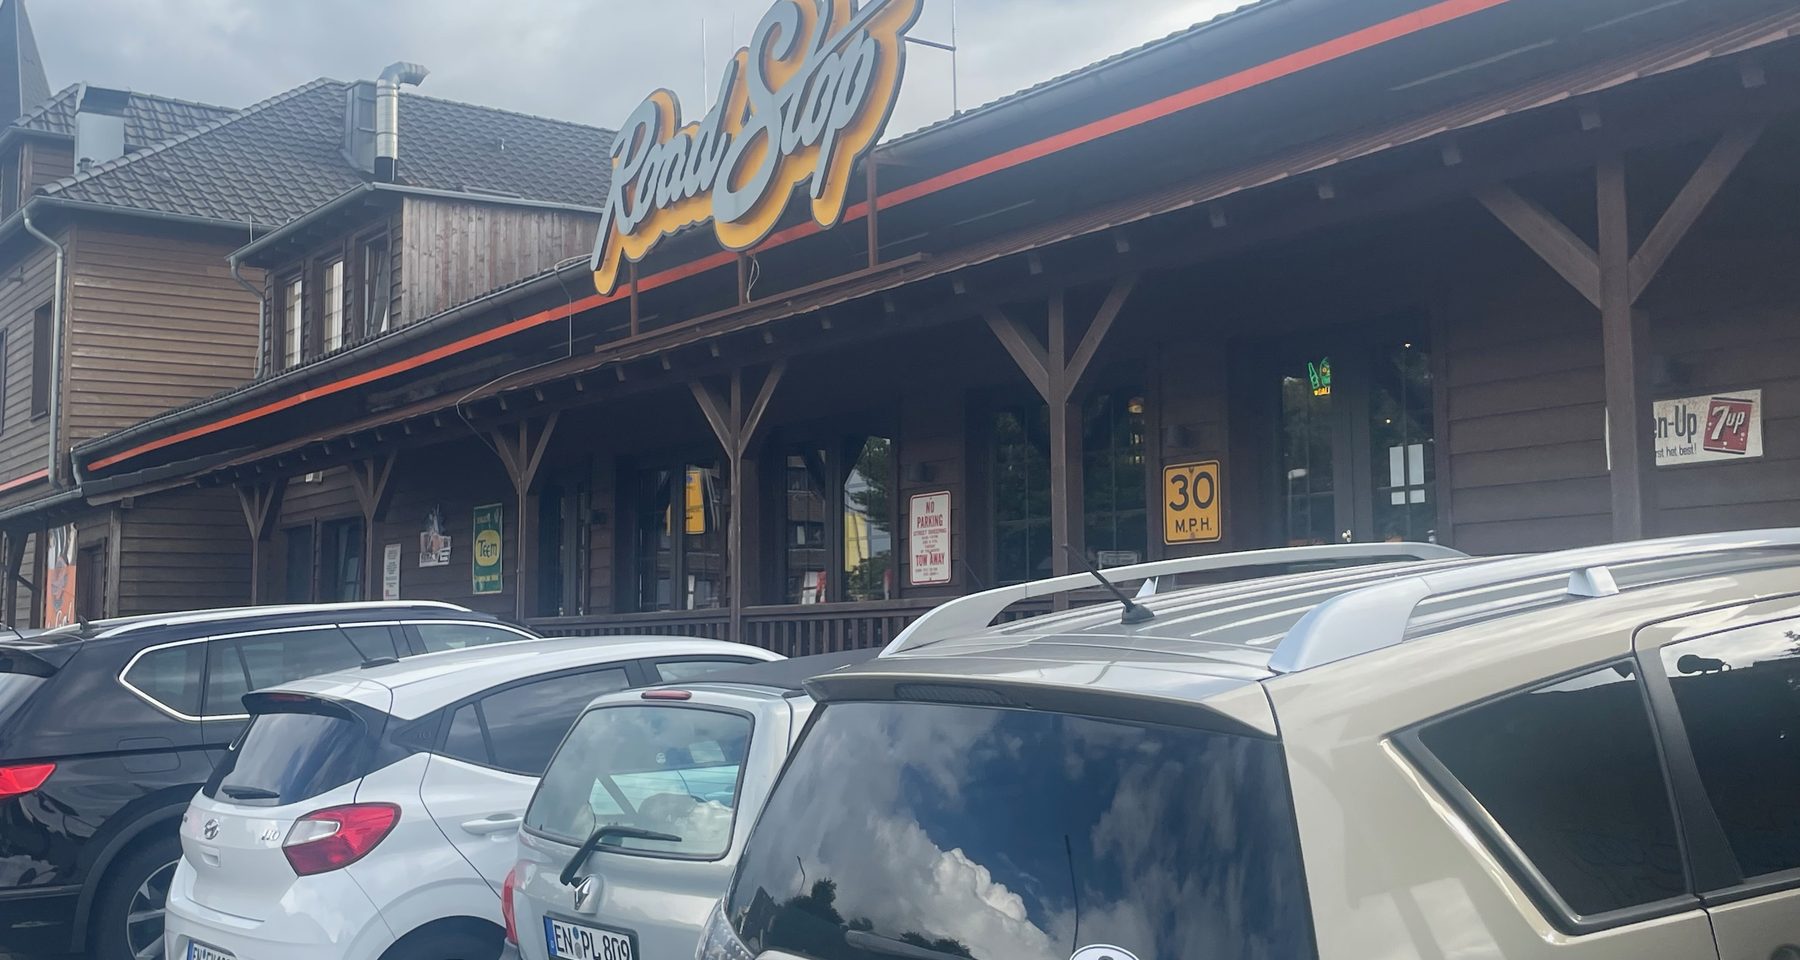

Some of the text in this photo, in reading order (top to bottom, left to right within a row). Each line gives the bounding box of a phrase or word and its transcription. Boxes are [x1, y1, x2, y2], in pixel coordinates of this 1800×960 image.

[590, 0, 893, 271] Road Stop
[1169, 471, 1214, 511] 30
[925, 501, 934, 514] NO
[917, 514, 943, 528] PARKING
[1175, 517, 1212, 533] M.P.H.
[915, 551, 945, 566] TOW AWAY
[554, 924, 630, 960] EN PL 809
